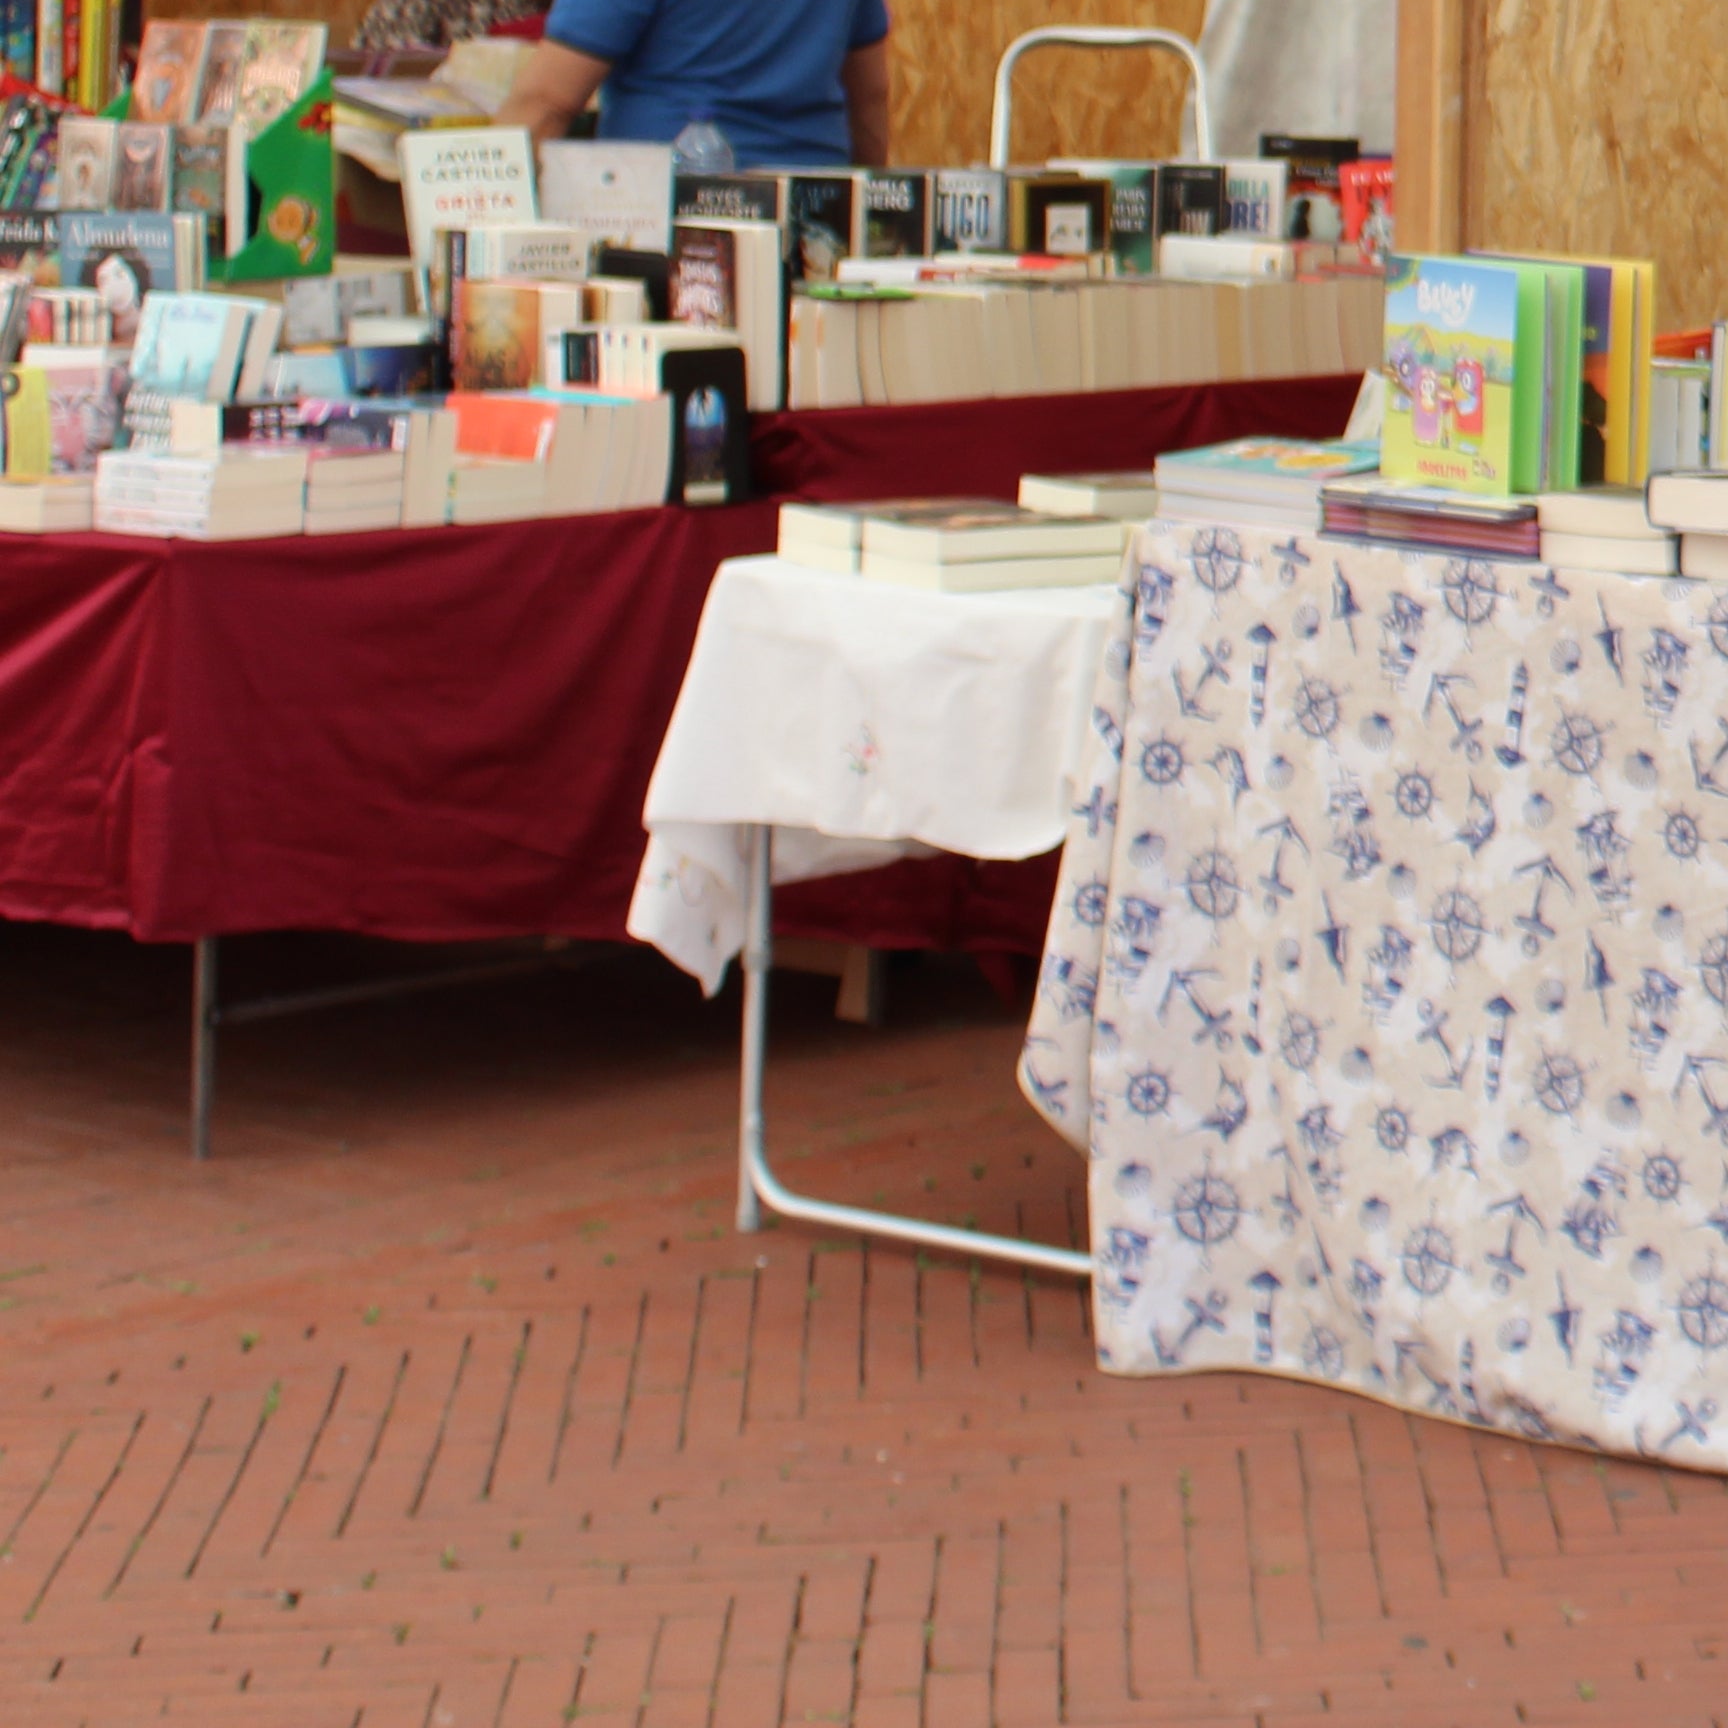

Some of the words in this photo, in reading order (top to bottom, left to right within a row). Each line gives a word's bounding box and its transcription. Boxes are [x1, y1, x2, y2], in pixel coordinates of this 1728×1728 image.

[435, 147, 504, 163] JAVIER
[420, 166, 520, 183] CASTILLO
[68, 219, 169, 249] Almudena
